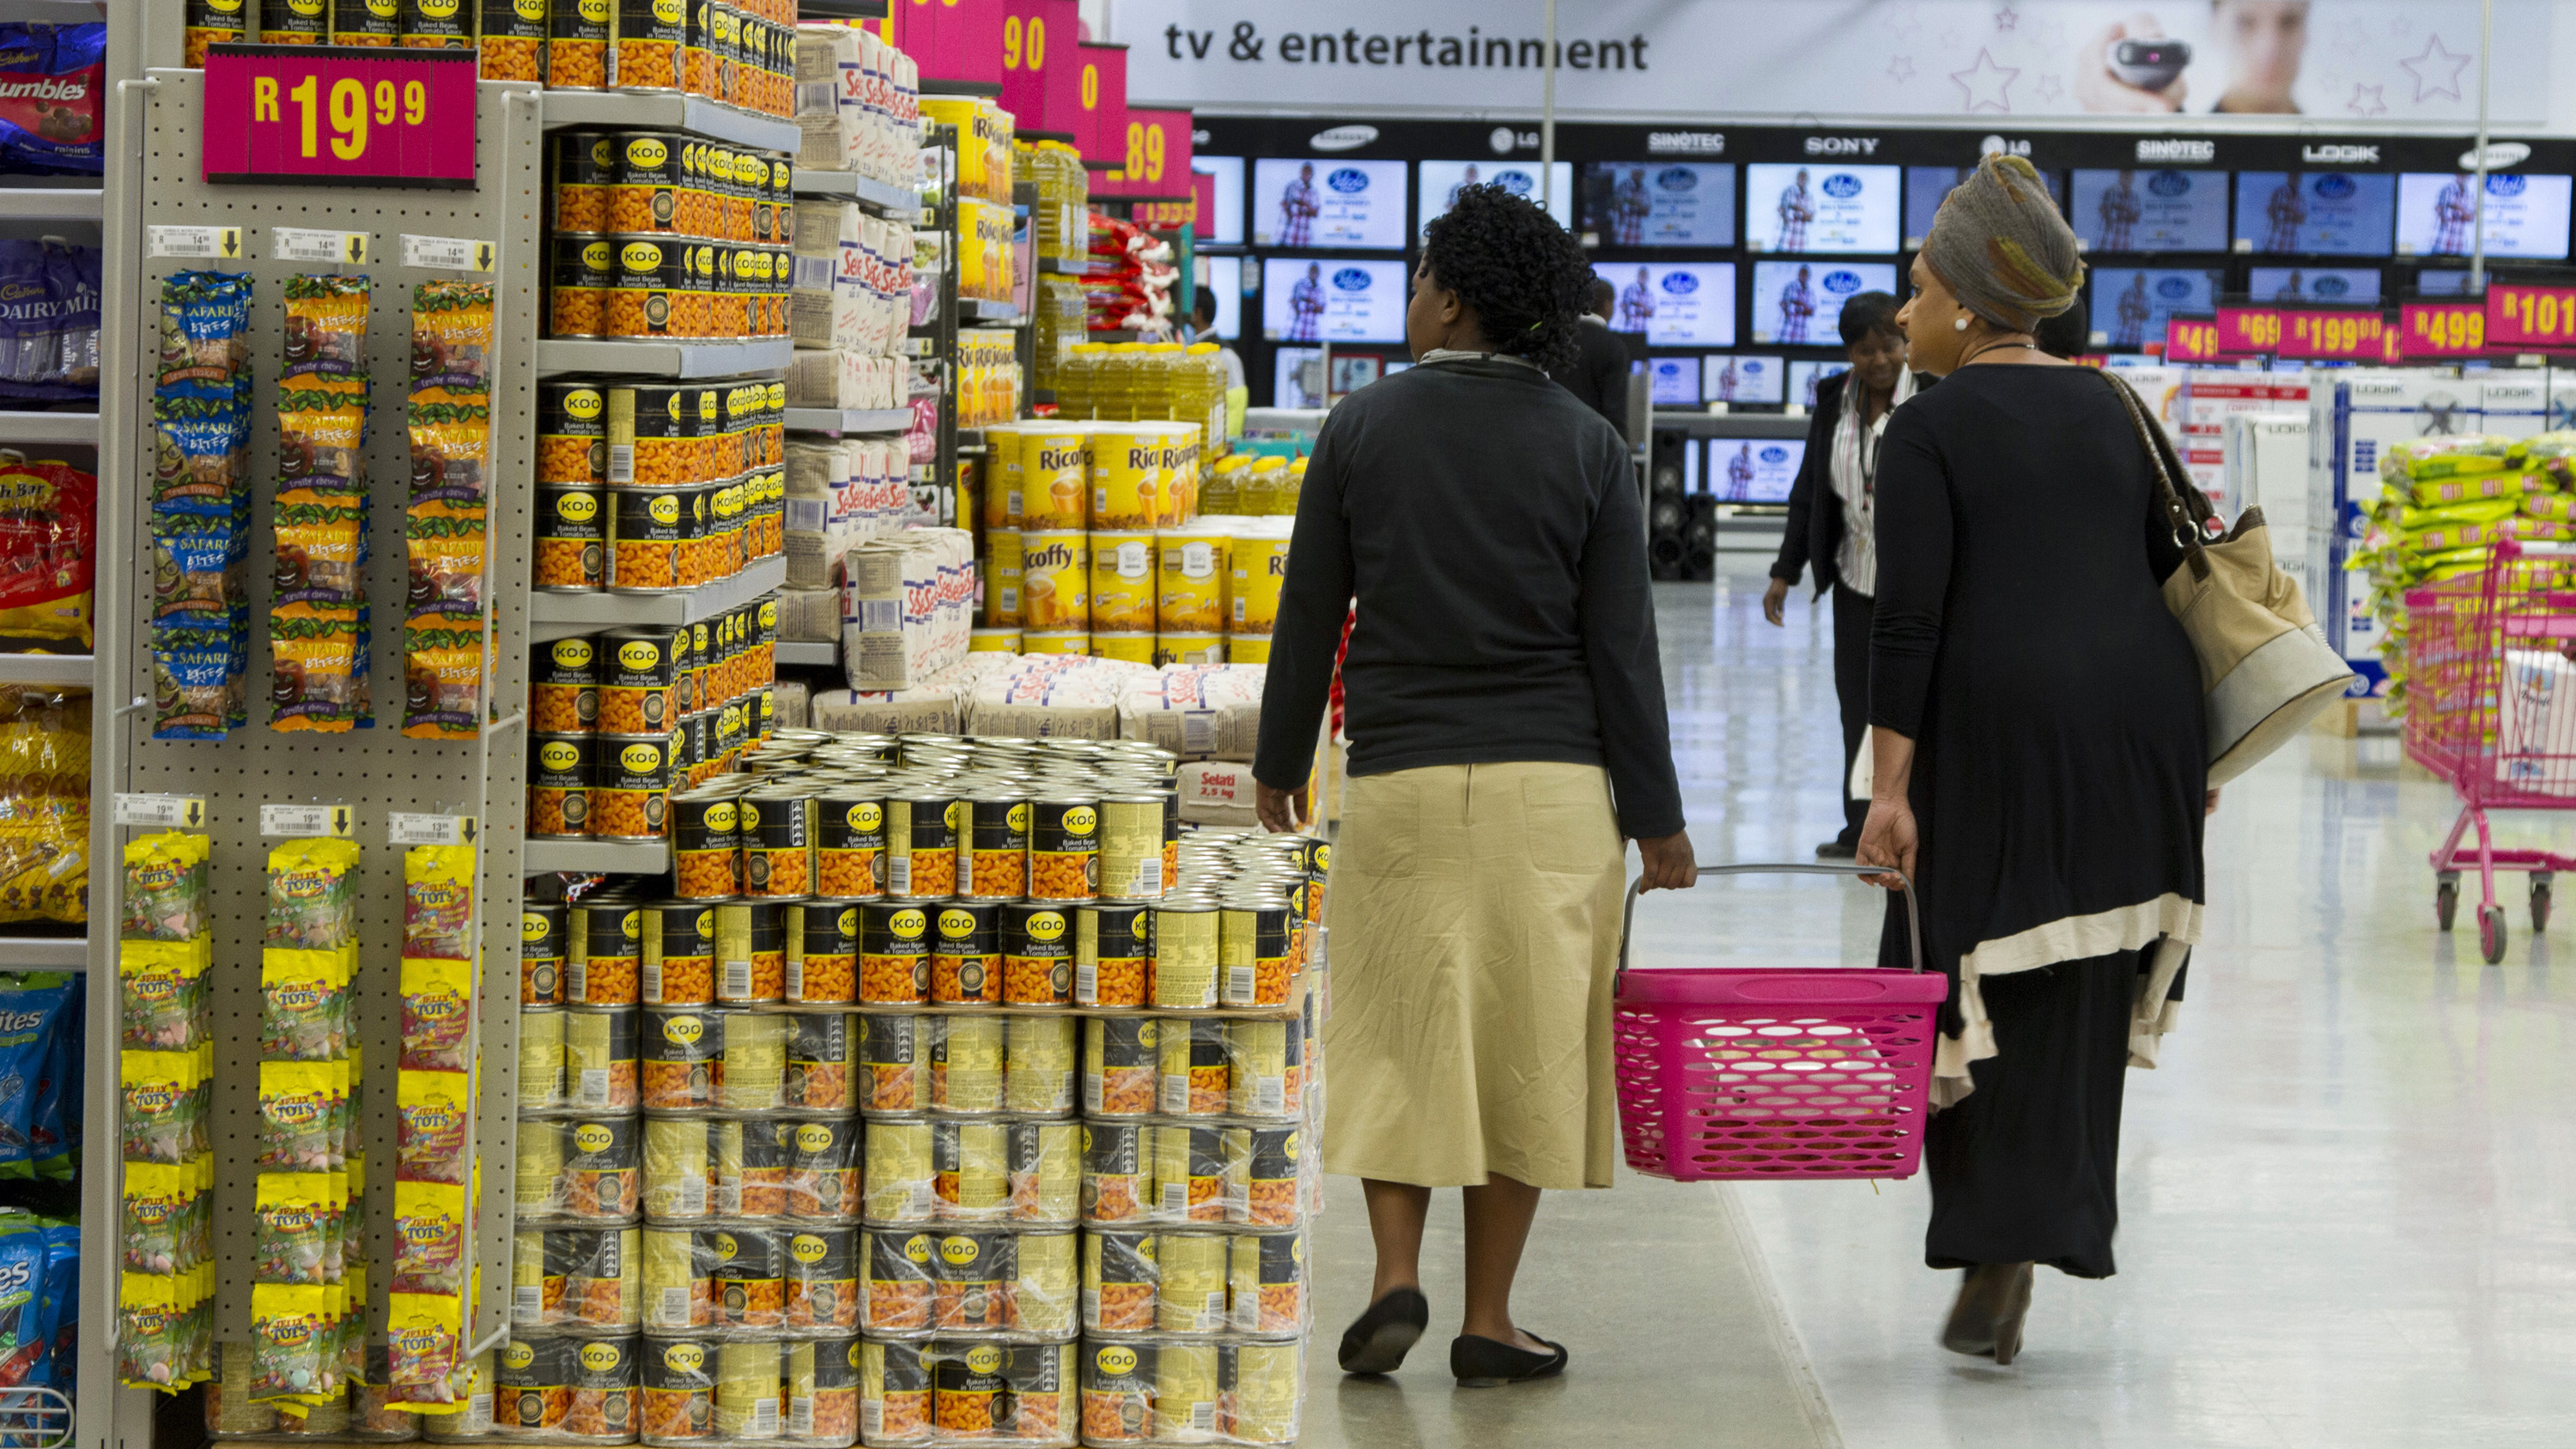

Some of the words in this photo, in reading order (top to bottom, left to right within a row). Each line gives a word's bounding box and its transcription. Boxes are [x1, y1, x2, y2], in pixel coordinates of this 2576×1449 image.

[1165, 23, 1212, 60] tv
[1229, 21, 1264, 60] &
[1279, 27, 1648, 70] entertainment
[1516, 132, 1540, 149] LG
[1648, 132, 1724, 149] SINOTEC
[1805, 137, 1879, 155] SONY
[630, 148, 665, 158] KOO
[2008, 140, 2032, 156] LG
[2136, 140, 2215, 156] SINOTEC
[2302, 145, 2381, 163] LOGIK
[624, 252, 660, 262] KOO
[2239, 313, 2281, 347] R69
[2415, 311, 2484, 349] R499
[568, 398, 600, 409] KOO
[561, 500, 595, 512] KOO
[556, 647, 590, 658] KOO
[622, 650, 657, 661] KOO
[544, 750, 576, 761] KOO
[624, 753, 658, 762] KOO
[1201, 772, 1235, 786] Selati
[708, 811, 737, 822] KOO
[851, 811, 880, 822] KOO
[1066, 815, 1096, 826] KOO
[139, 870, 174, 885] TOTS
[283, 877, 322, 893] TOTS
[417, 890, 453, 905] TOTS
[894, 919, 924, 929] KOO
[941, 919, 974, 929] KOO
[1030, 921, 1064, 931] KOO
[136, 981, 173, 995] TOTS
[415, 1002, 453, 1016] TOTS
[667, 1024, 702, 1035] KOO
[136, 1092, 172, 1107] TOTS
[275, 1102, 316, 1118] TOTS
[411, 1114, 450, 1129] TOTS
[577, 1132, 611, 1143] KOO
[798, 1132, 829, 1143] KOO
[272, 1214, 312, 1229] TOTS
[405, 1225, 444, 1240] TOTS
[793, 1245, 824, 1254] KOO
[943, 1244, 977, 1256] KOO
[269, 1325, 308, 1341] TOTS
[400, 1337, 436, 1350] TOTS
[581, 1351, 617, 1363] KOO
[669, 1351, 703, 1363] KOO
[970, 1354, 1000, 1364] KOO
[1101, 1353, 1135, 1364] KOO
